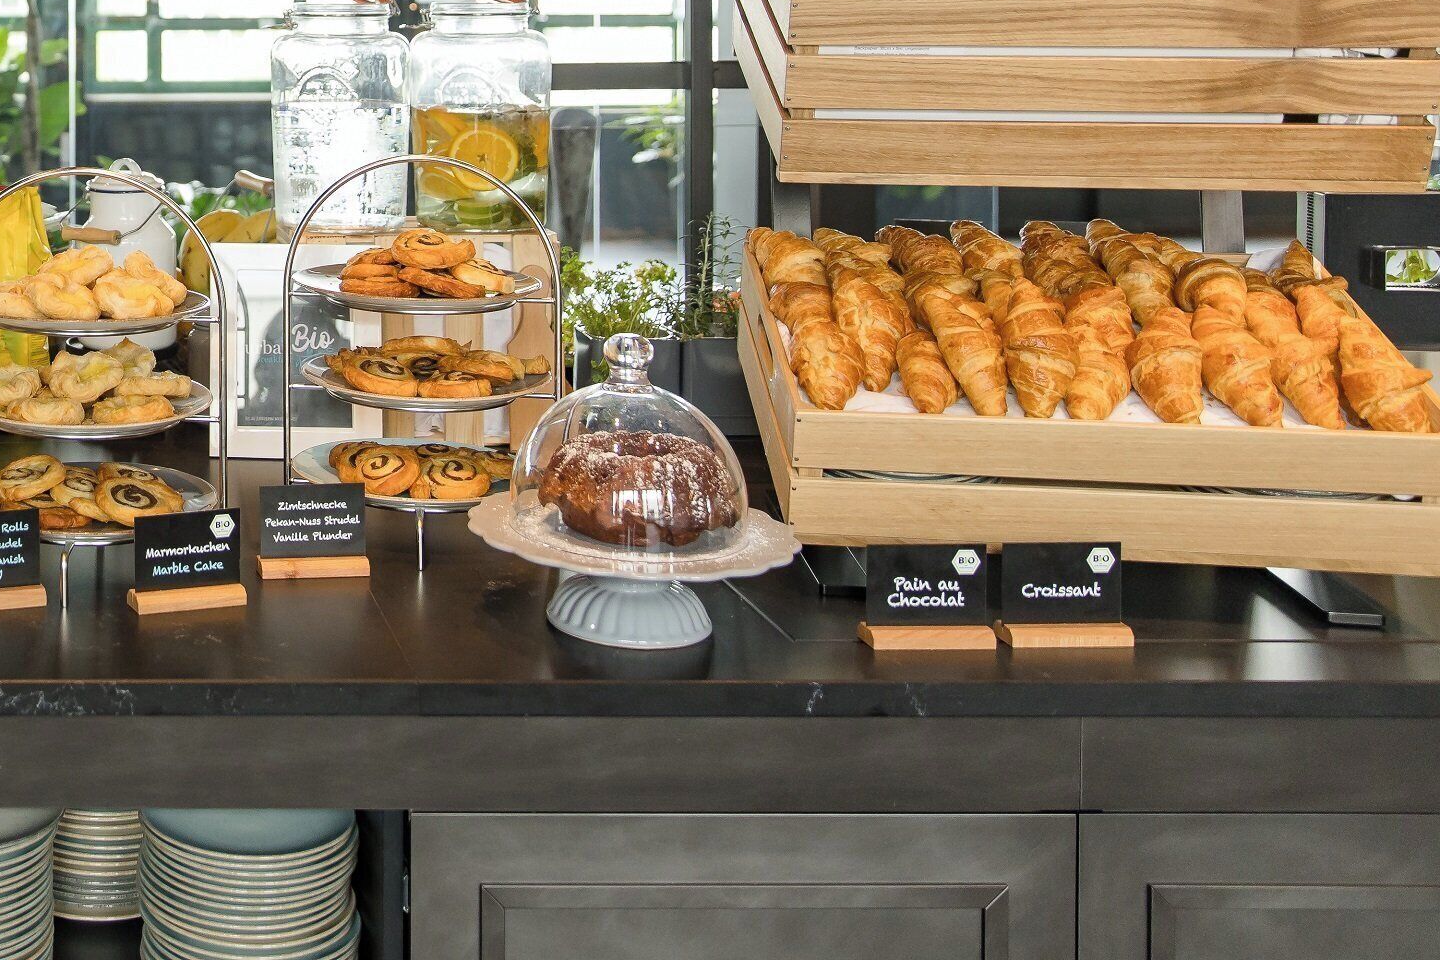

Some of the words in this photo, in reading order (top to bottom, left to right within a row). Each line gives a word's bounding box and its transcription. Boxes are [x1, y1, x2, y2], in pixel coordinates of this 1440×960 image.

[291, 323, 335, 353] Bio
[277, 500, 348, 511] Zimtschnecke
[1, 521, 29, 533] Rolls
[264, 517, 322, 527] Pekan-Nuss
[324, 514, 361, 526] Strudel
[272, 531, 310, 543] Vanille
[312, 529, 353, 541] Plunder
[145, 541, 230, 559] Marmorkuchen
[152, 562, 191, 576] Marble
[194, 560, 225, 572] Cake
[893, 576, 932, 592] Pain
[937, 580, 960, 591] au
[1021, 581, 1102, 598] Croissant
[887, 591, 965, 608] Chocolat
